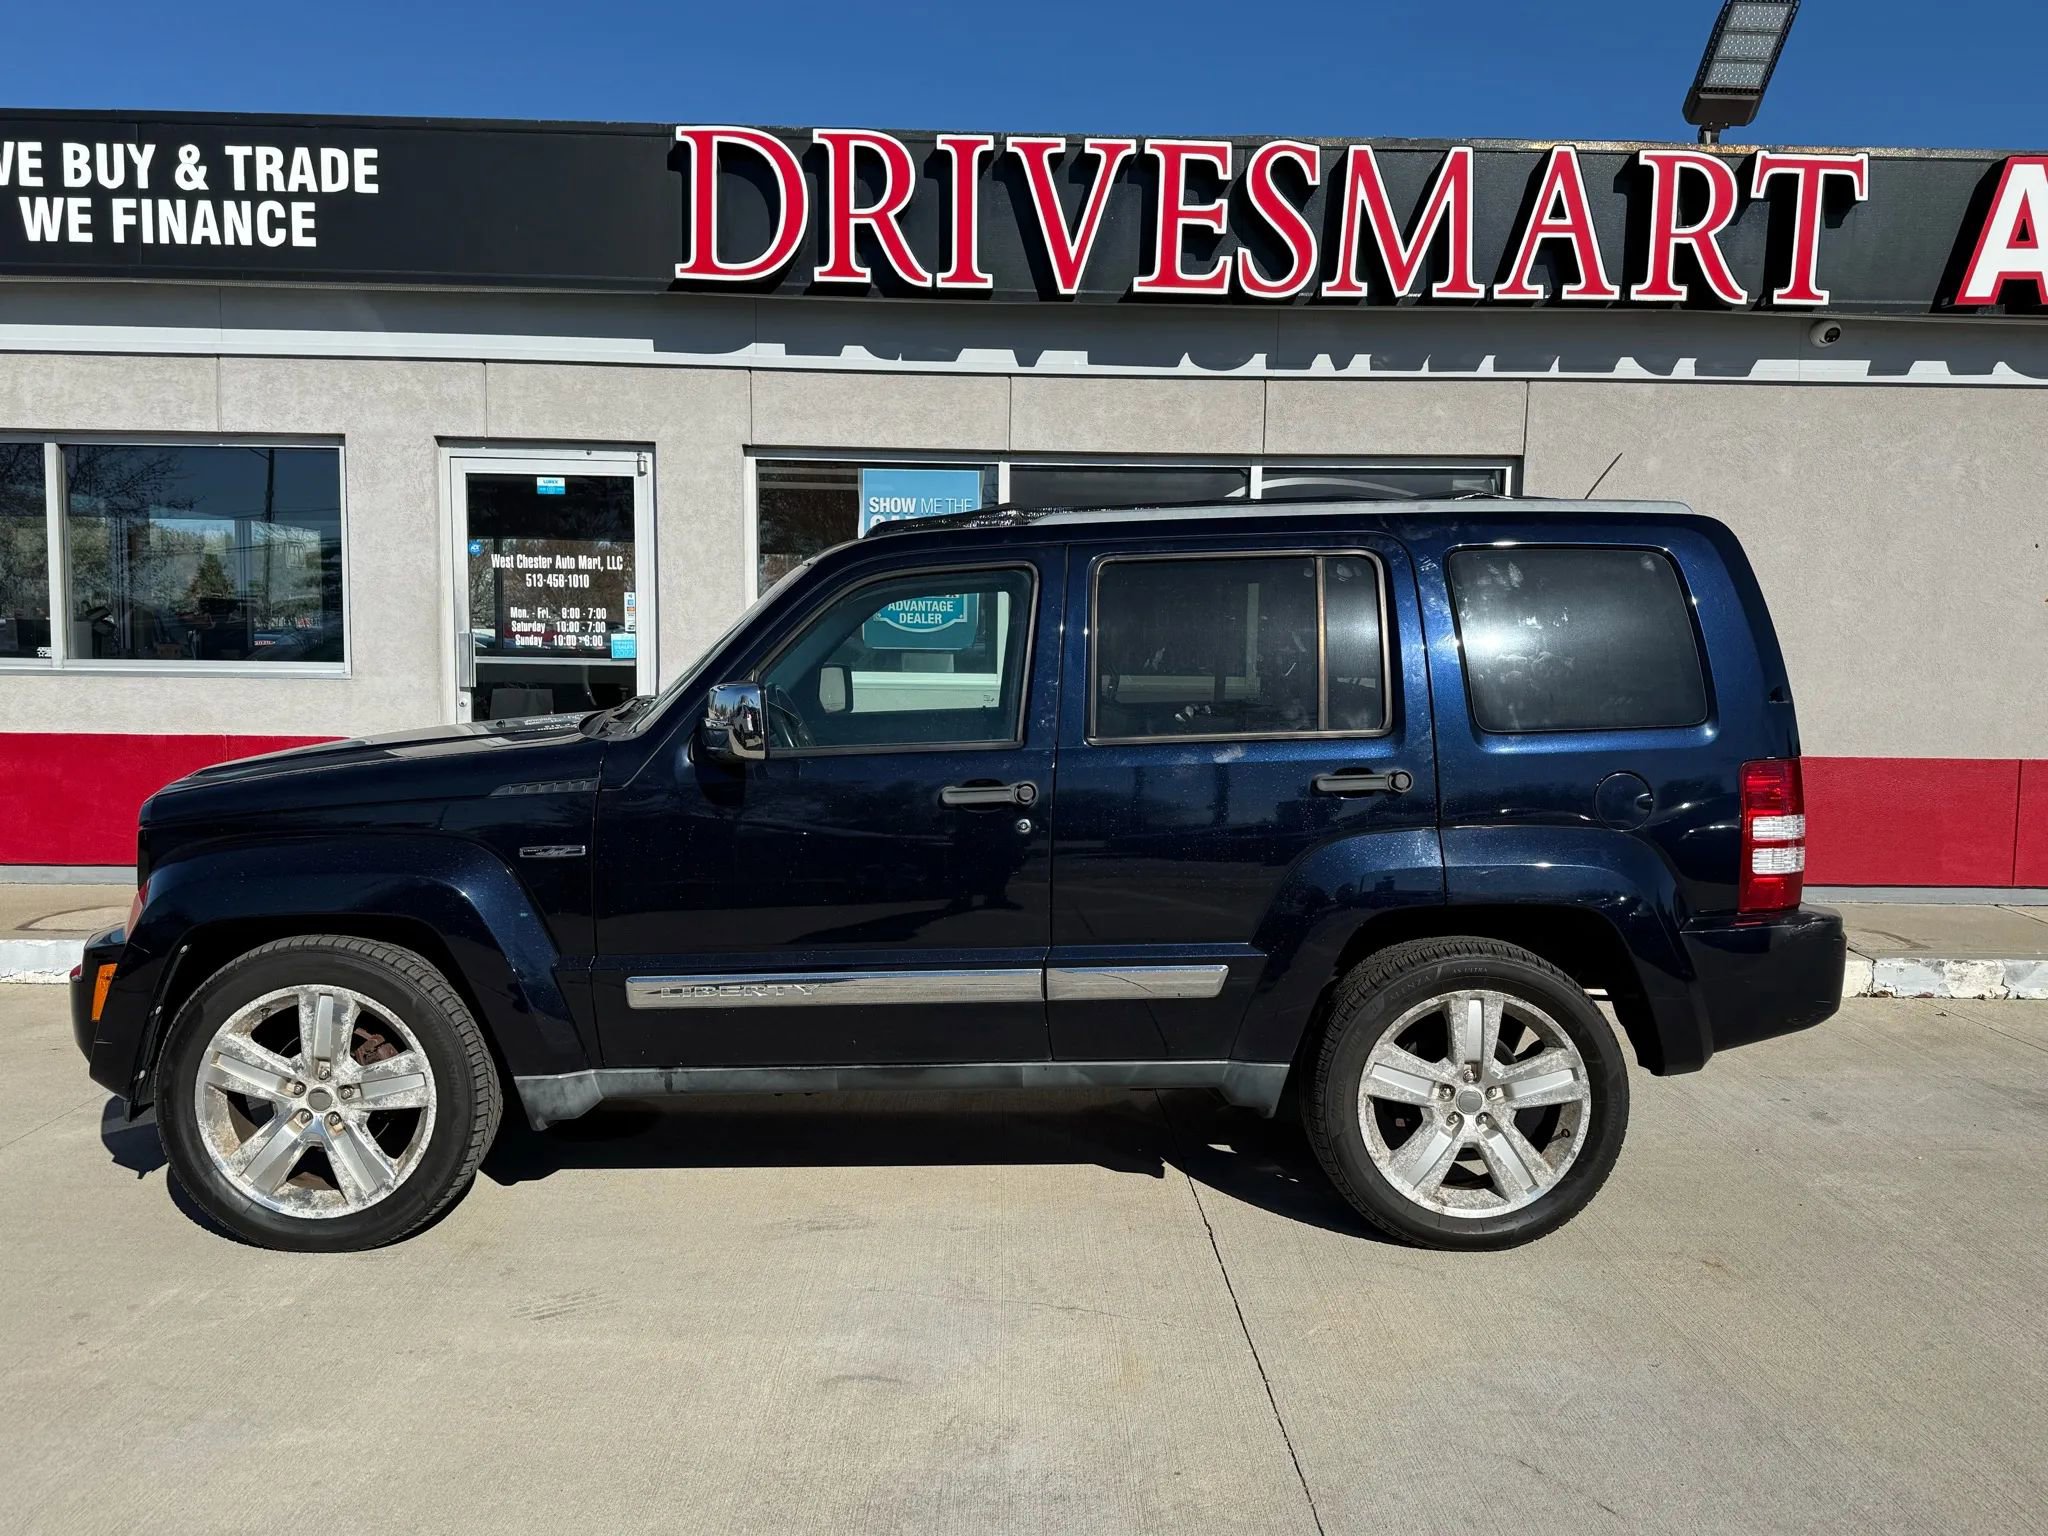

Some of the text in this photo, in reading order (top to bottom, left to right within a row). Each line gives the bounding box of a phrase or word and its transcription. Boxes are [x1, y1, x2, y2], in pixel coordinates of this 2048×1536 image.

[62, 142, 156, 189] BUY
[174, 143, 209, 191] &
[224, 145, 380, 194] TRADE
[18, 196, 317, 247] WE FINANCE
[675, 125, 1870, 307] DRIVESMART
[869, 496, 973, 514] SHOW ME THE
[491, 554, 624, 572] West Chester Auto Mart, LLC
[510, 606, 529, 619] Mon.
[537, 607, 551, 619] Fri.
[588, 607, 607, 619] 7:00
[887, 600, 954, 612] ADVANTAGE
[899, 612, 942, 624] DEALER
[511, 620, 546, 634] Saturday
[556, 621, 580, 633] 10:00
[587, 621, 606, 633] 7:00
[515, 634, 543, 647] Sunday
[553, 634, 577, 646] 10:00
[661, 983, 821, 998] LIBERTY
